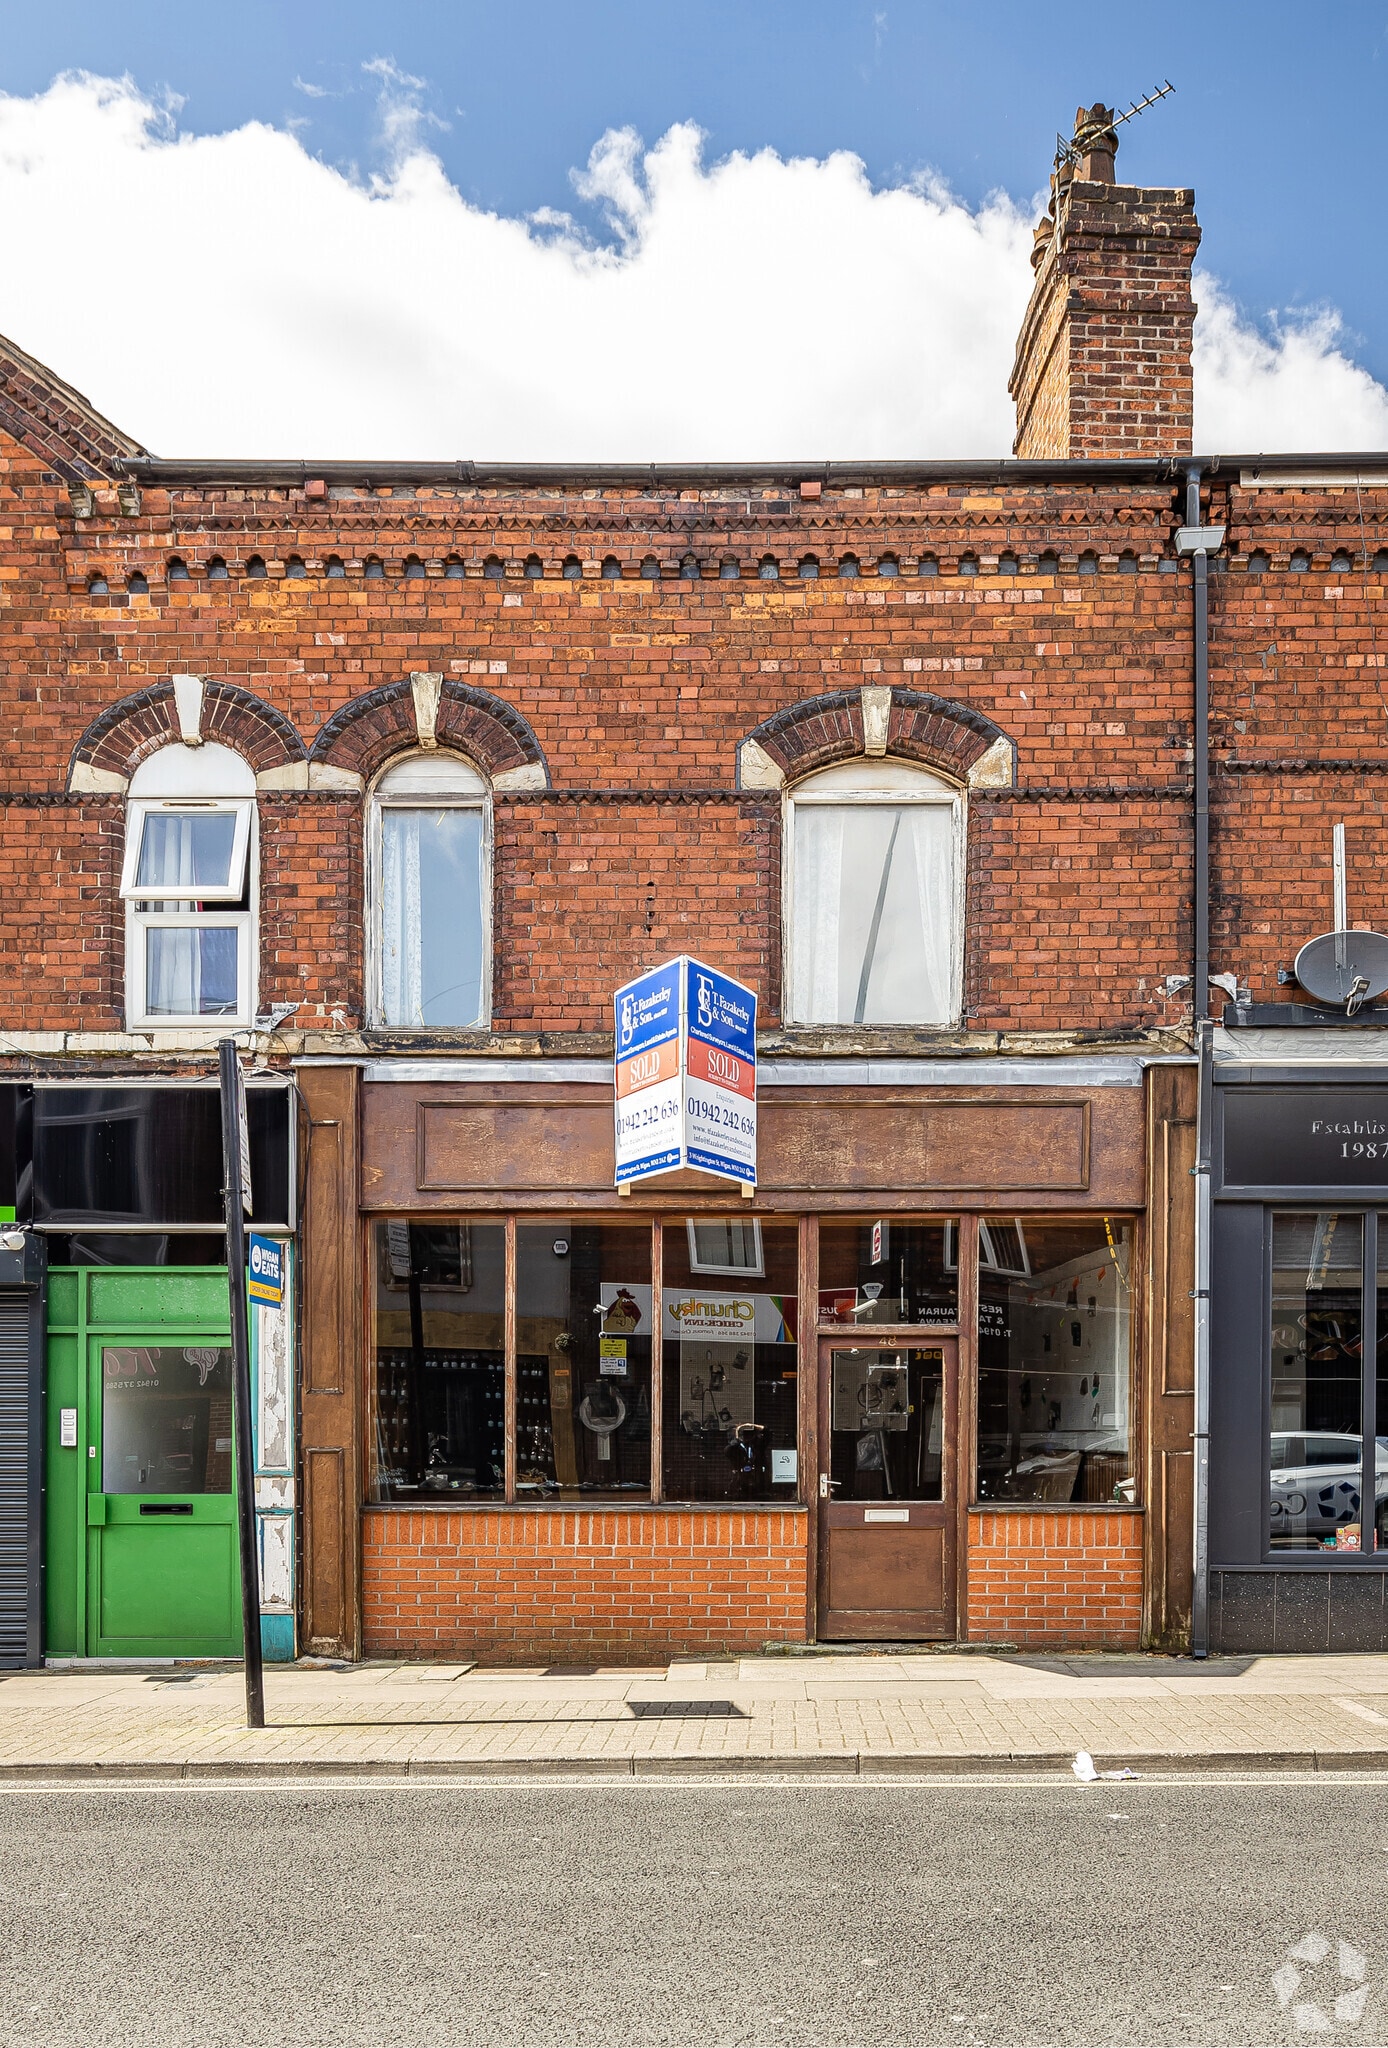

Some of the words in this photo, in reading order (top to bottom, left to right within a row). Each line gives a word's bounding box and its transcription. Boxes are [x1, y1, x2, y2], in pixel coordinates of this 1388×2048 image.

[712, 1006, 720, 1020] &
[720, 1010, 734, 1028] Son.
[719, 994, 750, 1024] Fazakerley
[633, 1016, 639, 1029] &
[630, 1051, 660, 1084] SOLD
[708, 1050, 740, 1082] SOLD
[617, 1111, 639, 1135] 01942
[643, 1104, 658, 1126] 242
[661, 1097, 678, 1120] 636
[688, 1097, 720, 1124] 01942
[723, 1109, 739, 1130] 242
[741, 1117, 755, 1137] 636
[1311, 1120, 1388, 1134] Establis
[1340, 1142, 1388, 1158] 1987
[261, 1248, 279, 1265] WIGAN
[261, 1261, 279, 1279] EATS
[879, 1336, 897, 1346] 48
